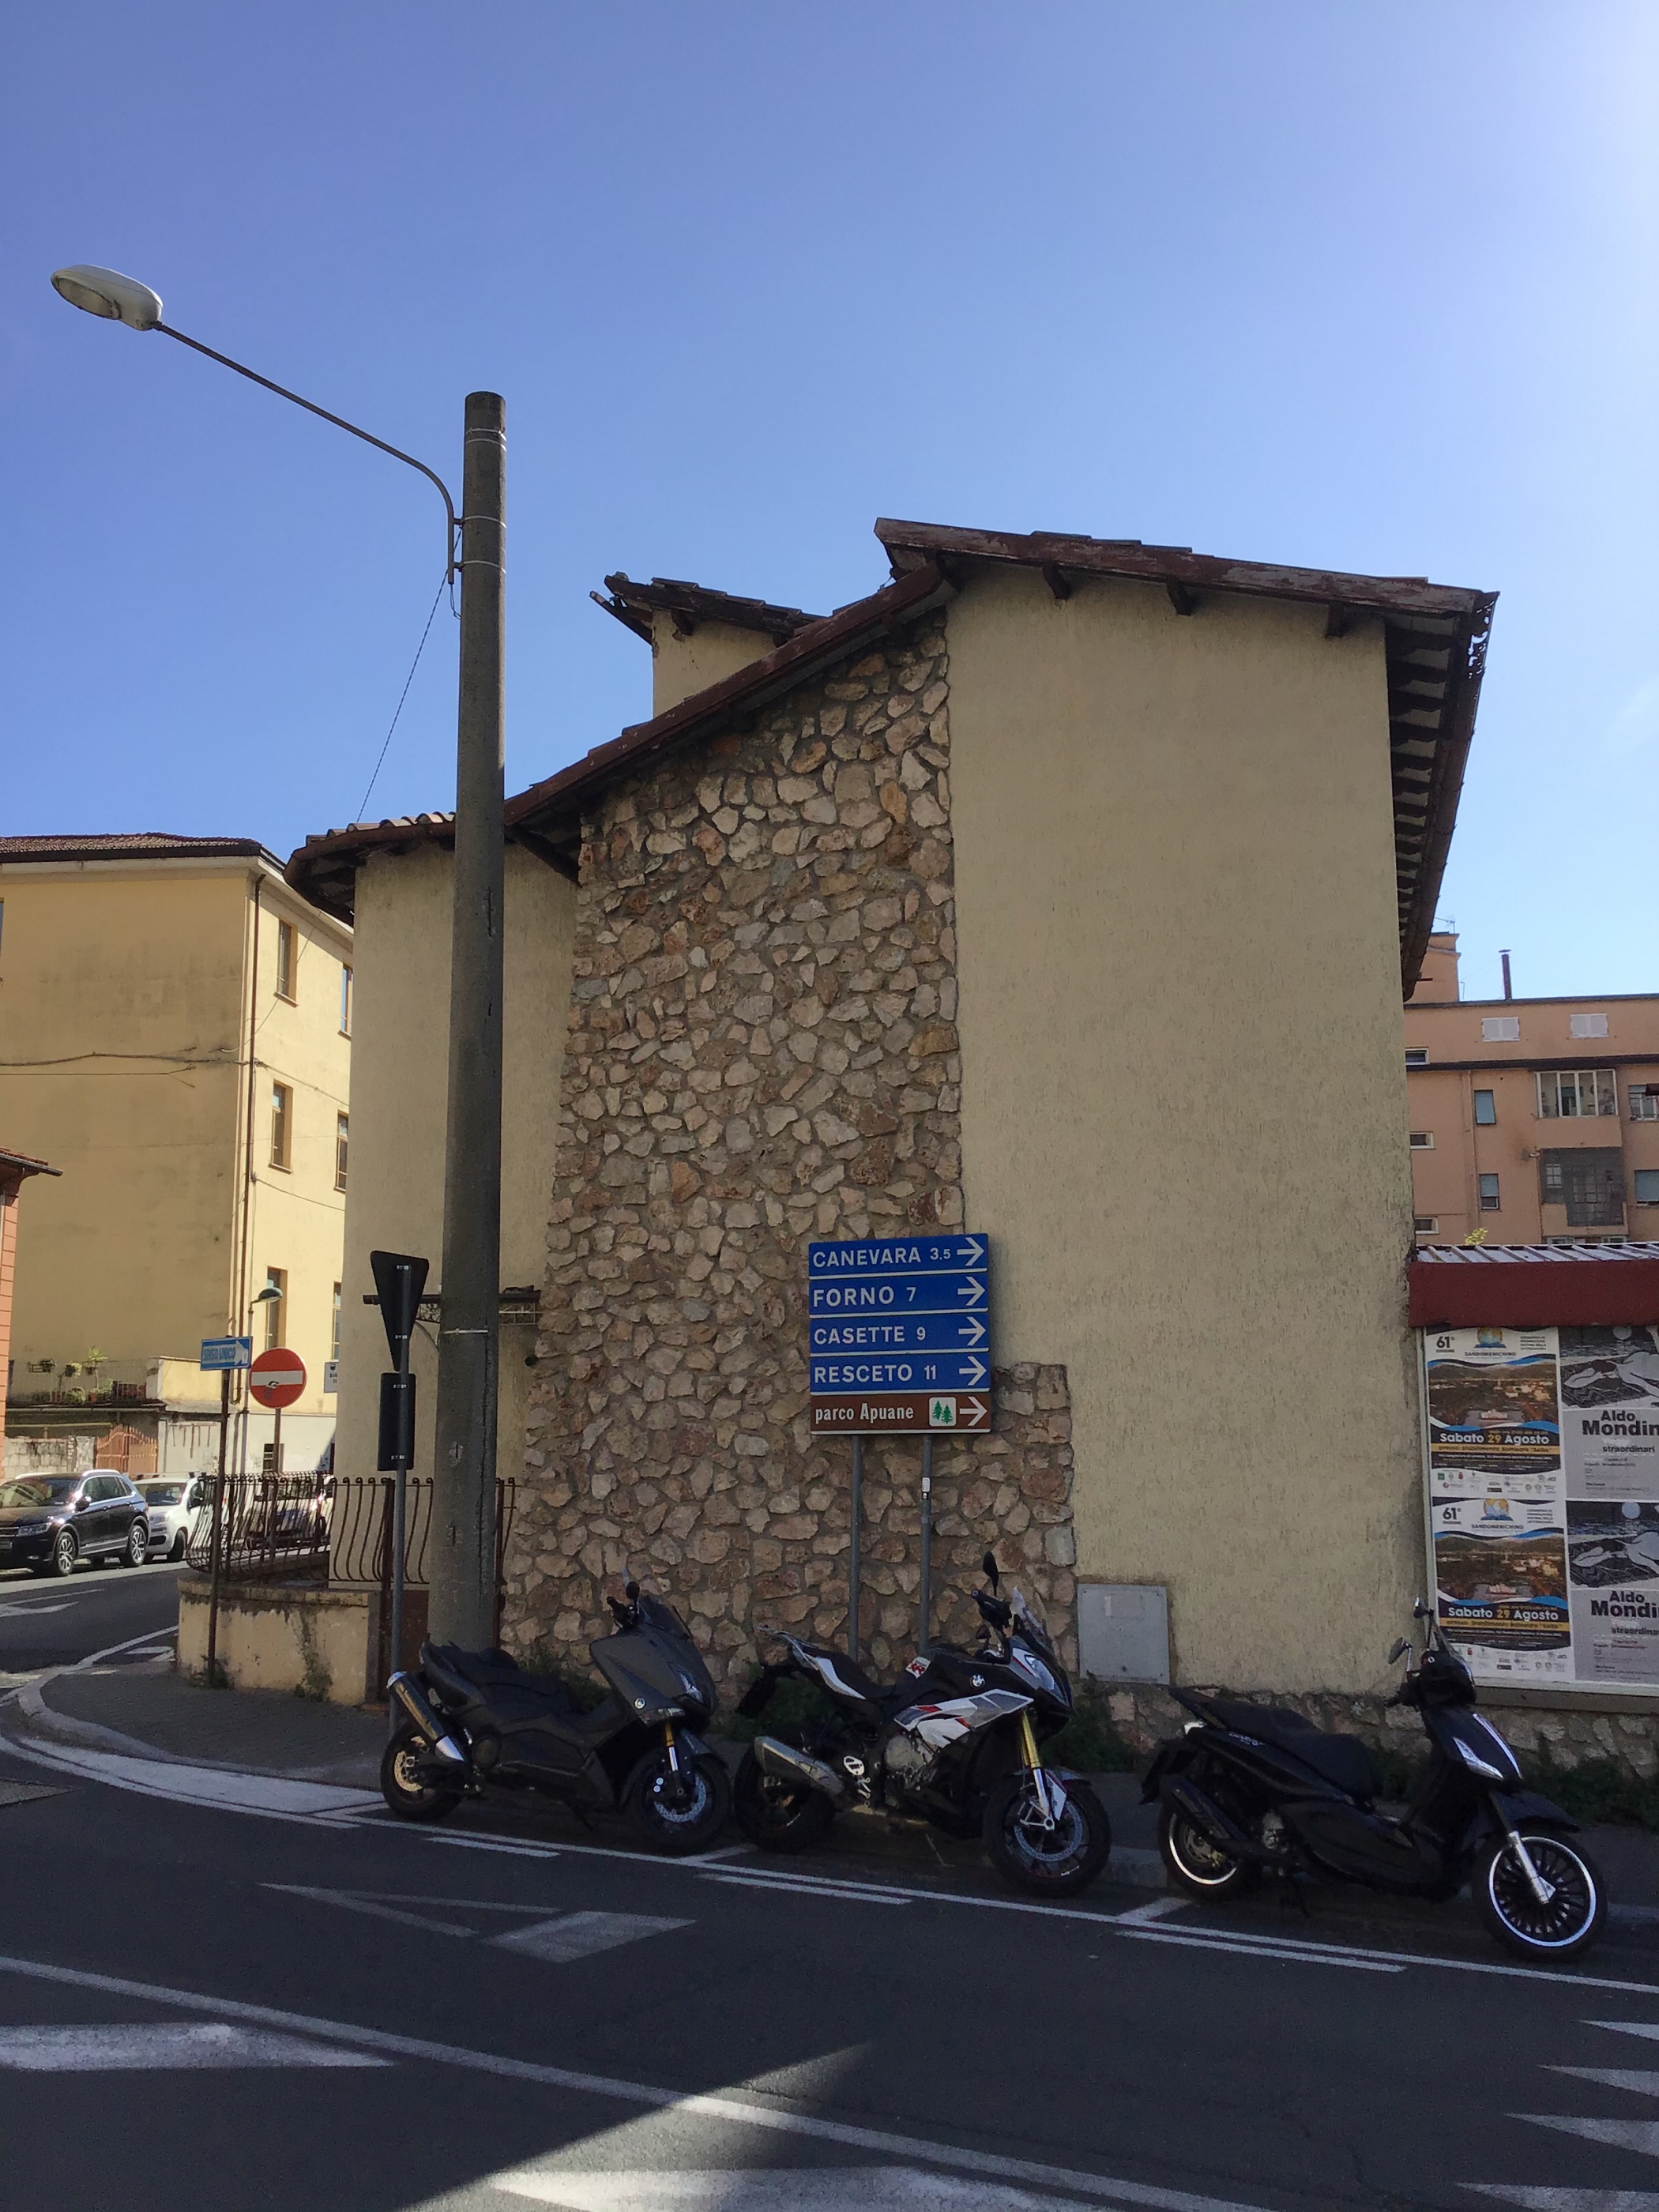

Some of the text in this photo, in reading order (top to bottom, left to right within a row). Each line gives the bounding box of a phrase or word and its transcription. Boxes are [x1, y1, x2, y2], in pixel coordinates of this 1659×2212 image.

[813, 1247, 921, 1267] CANEVARA
[813, 1285, 916, 1307] FORNO 7
[814, 1326, 926, 1345] CASETTE 9
[219, 1347, 236, 1360] UNICO
[814, 1364, 937, 1383] RESCETO 11
[815, 1402, 914, 1424] parco Apuane
[1601, 1410, 1636, 1421] Aldo
[1439, 1432, 1550, 1446] Sabato 29 Agosto
[1609, 1590, 1645, 1603] Aldo
[1448, 1607, 1493, 1618] Sabato
[1496, 1609, 1510, 1619] 29
[1514, 1610, 1559, 1622] Agosto
[1591, 1600, 1659, 1619] Mondi
[1612, 1627, 1659, 1636] straordina
